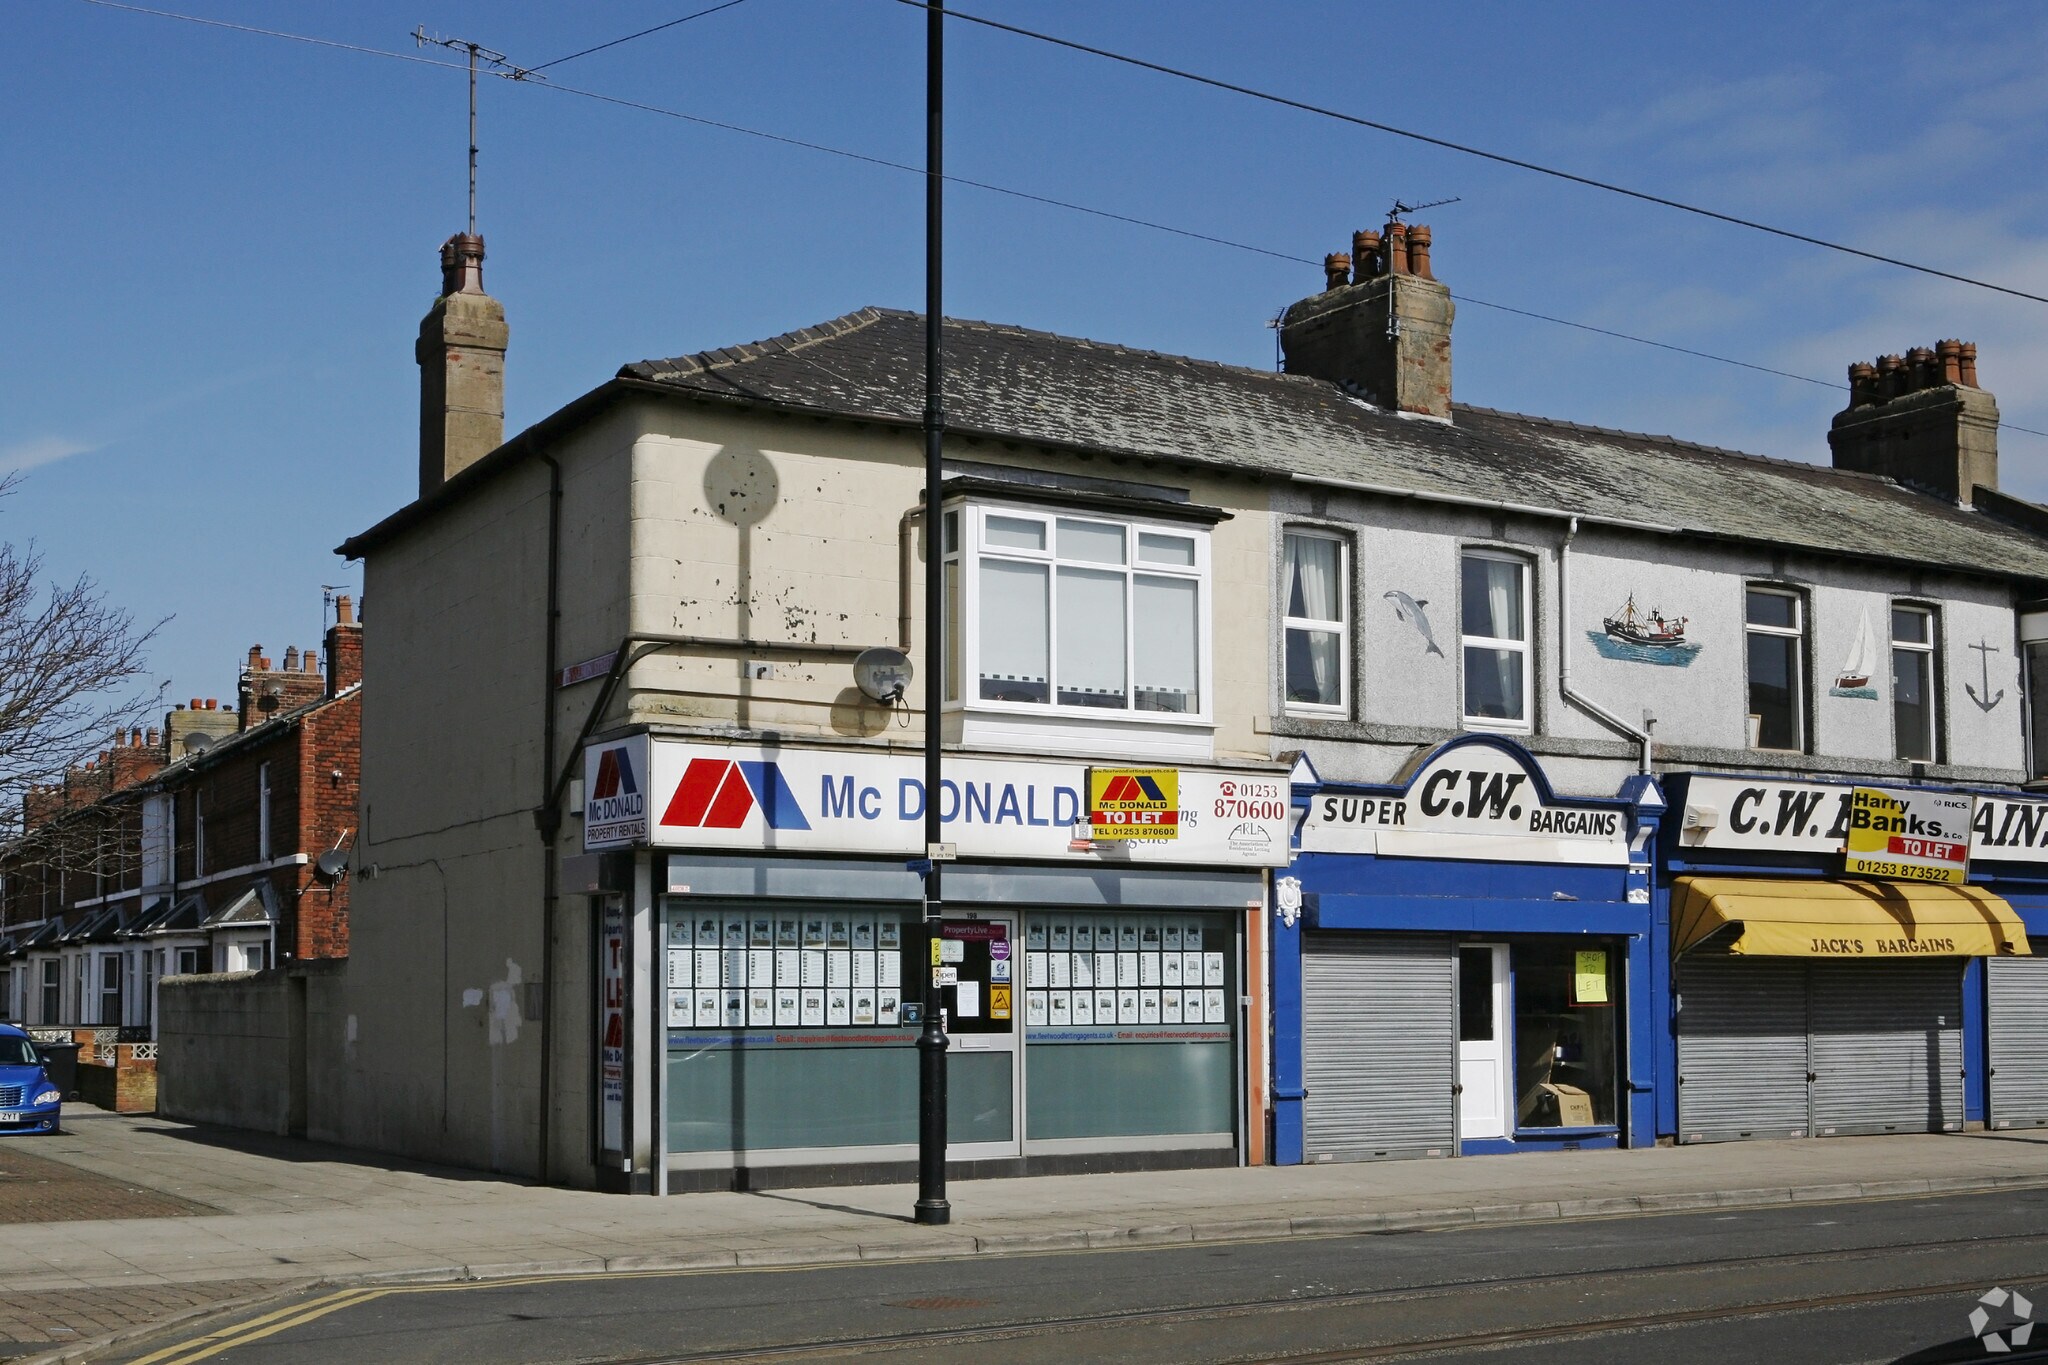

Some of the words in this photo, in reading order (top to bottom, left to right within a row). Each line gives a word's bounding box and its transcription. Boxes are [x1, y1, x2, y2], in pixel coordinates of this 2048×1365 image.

[821, 774, 882, 820] Mc
[899, 778, 1079, 827] DONALD
[1240, 784, 1278, 798] 01253
[1420, 769, 1527, 821] C.W.
[589, 802, 601, 821] Mc
[604, 794, 643, 819] DONALD
[1214, 799, 1284, 820] 870600
[1322, 798, 1407, 825] SUPER
[1729, 788, 1825, 837] C.W.
[1854, 793, 1910, 814] Harry
[1944, 800, 1968, 810] RICS
[1103, 812, 1126, 824] TO
[1131, 812, 1163, 824] LET
[1529, 810, 1617, 835] BARGAINS
[1851, 808, 1942, 837] Banks
[588, 824, 617, 841] PROPERTY
[619, 822, 646, 837] RENTALS
[1903, 839, 1922, 855] TO
[1925, 842, 1953, 859] LET
[1857, 860, 1897, 875] 01253
[1901, 865, 1950, 881] 873522
[1811, 939, 1864, 954] JACK'S
[1875, 938, 1955, 953] BARGAINS
[1580, 952, 1603, 962] SHOP
[1584, 964, 1596, 974] TO
[1578, 978, 1602, 992] LET
